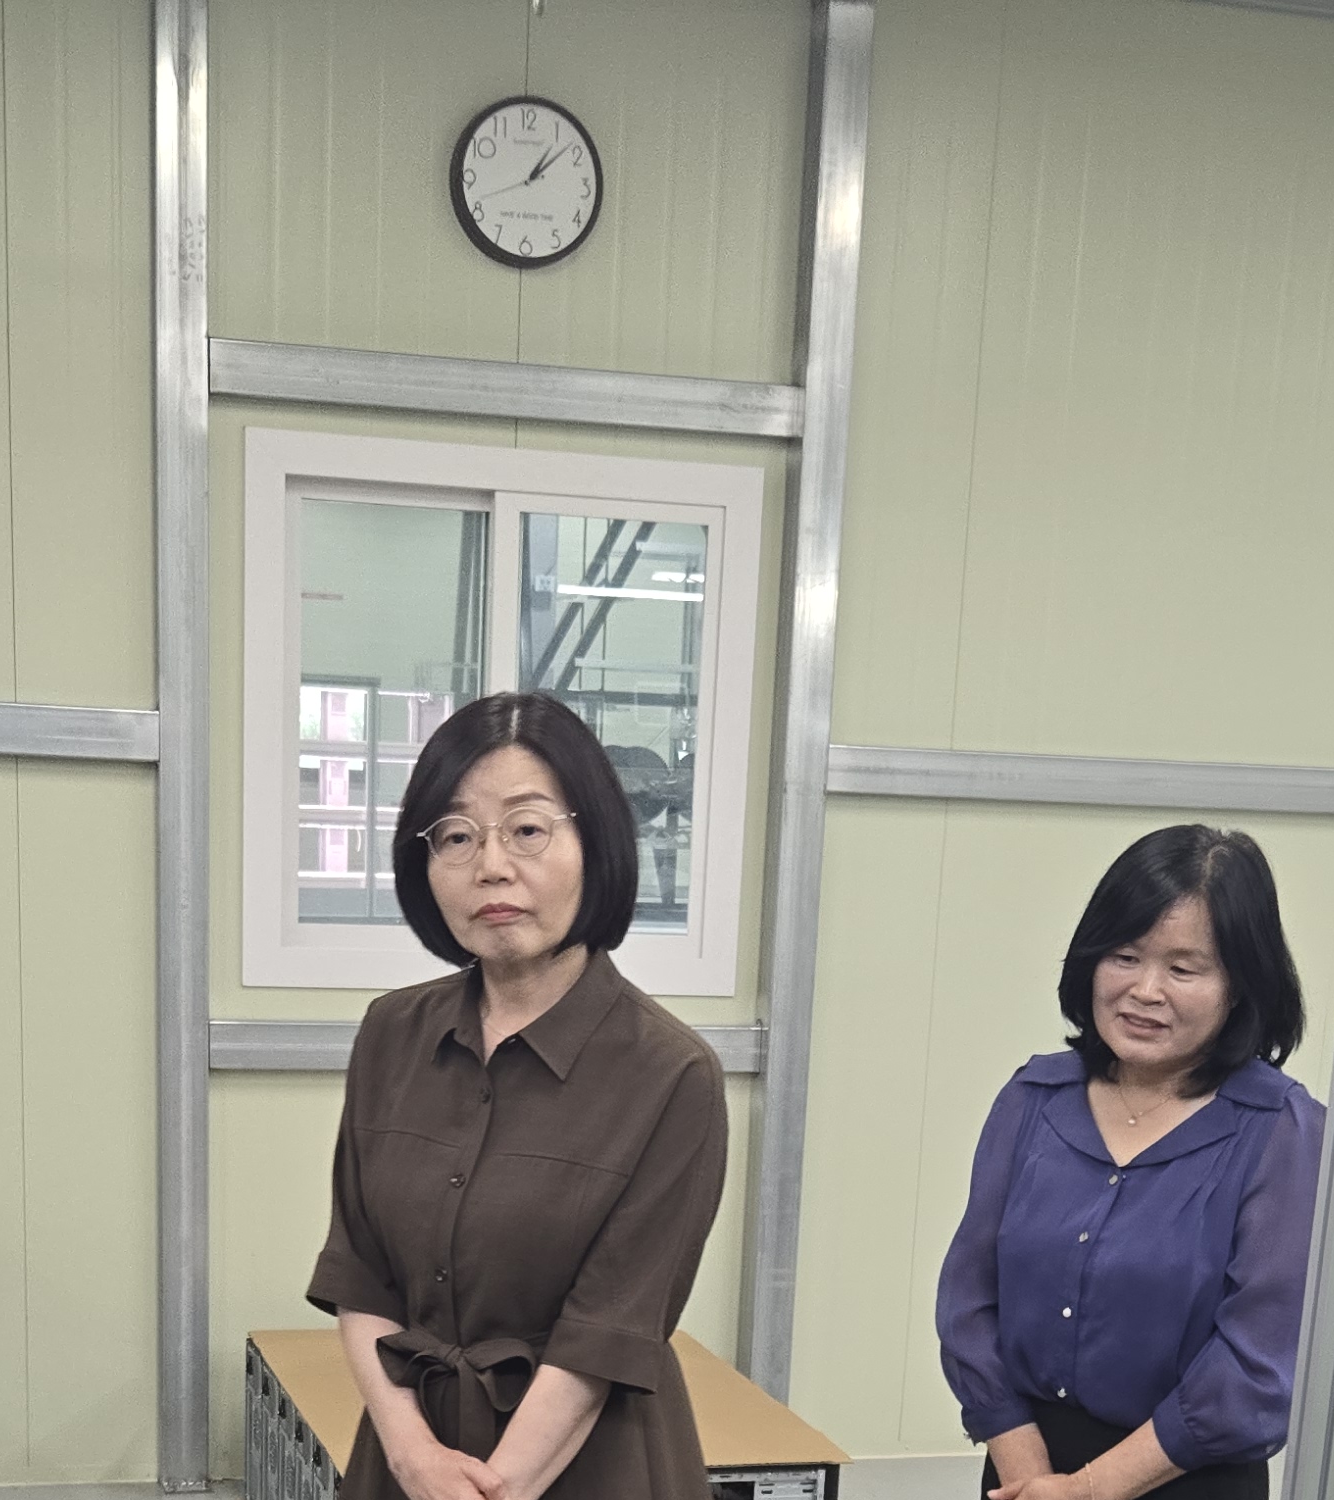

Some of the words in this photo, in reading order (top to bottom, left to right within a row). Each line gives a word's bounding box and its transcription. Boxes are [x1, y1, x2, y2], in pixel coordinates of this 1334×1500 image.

[493, 115, 507, 139] 11
[521, 107, 537, 131] 12
[555, 121, 560, 143] 1
[472, 136, 496, 159] 10
[572, 145, 583, 168] 2
[463, 168, 477, 191] 9
[580, 176, 592, 199] 3
[472, 201, 484, 223] 8
[572, 209, 582, 229] 4
[495, 224, 503, 245] 7
[551, 228, 562, 250] 5
[519, 235, 533, 257] 6
